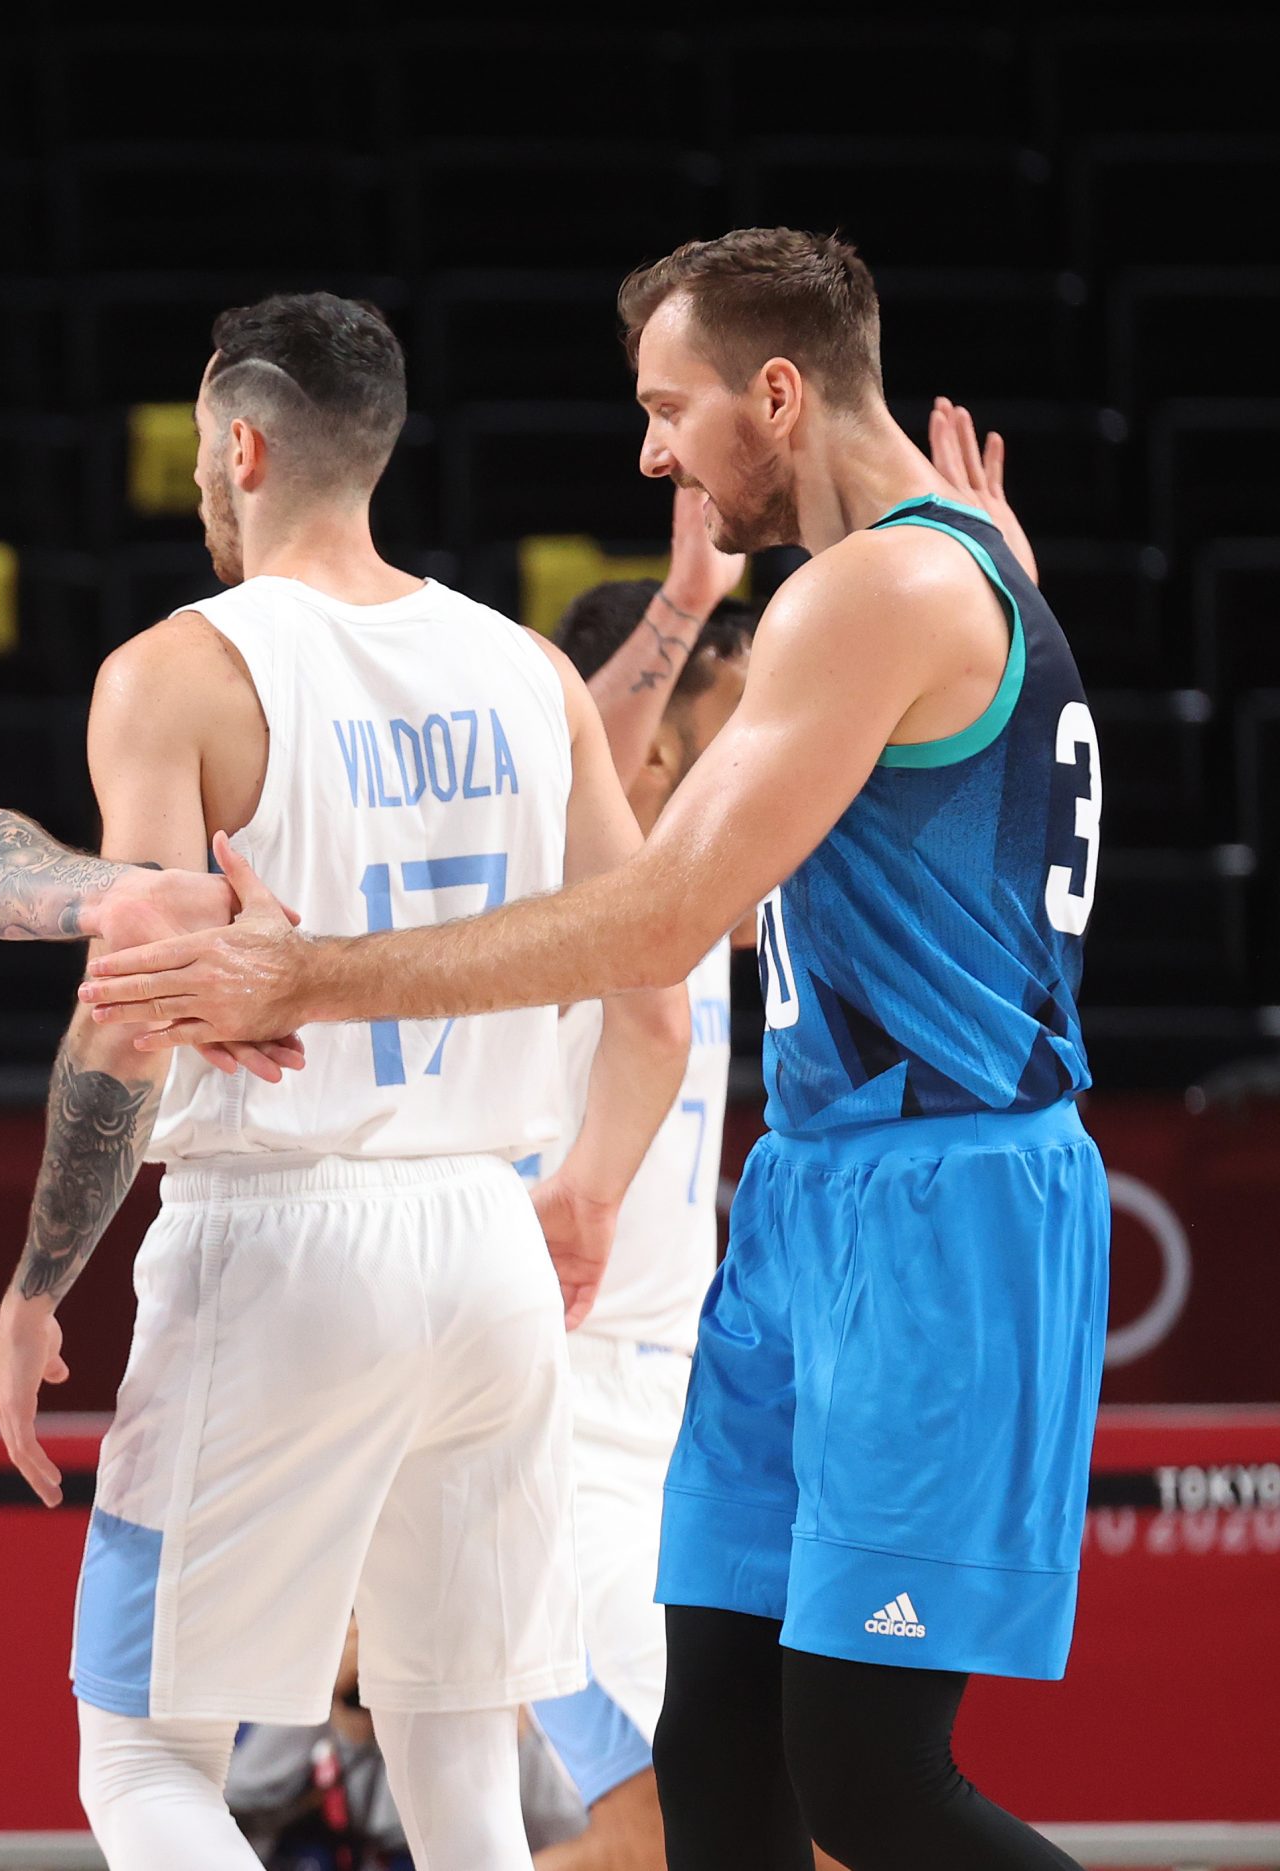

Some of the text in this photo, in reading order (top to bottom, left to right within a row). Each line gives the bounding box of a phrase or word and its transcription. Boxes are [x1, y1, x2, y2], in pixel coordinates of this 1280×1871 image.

[333, 708, 519, 808] VILDOZA
[1155, 1464, 1280, 1512] TOKYO
[864, 1618, 926, 1639] adidas
